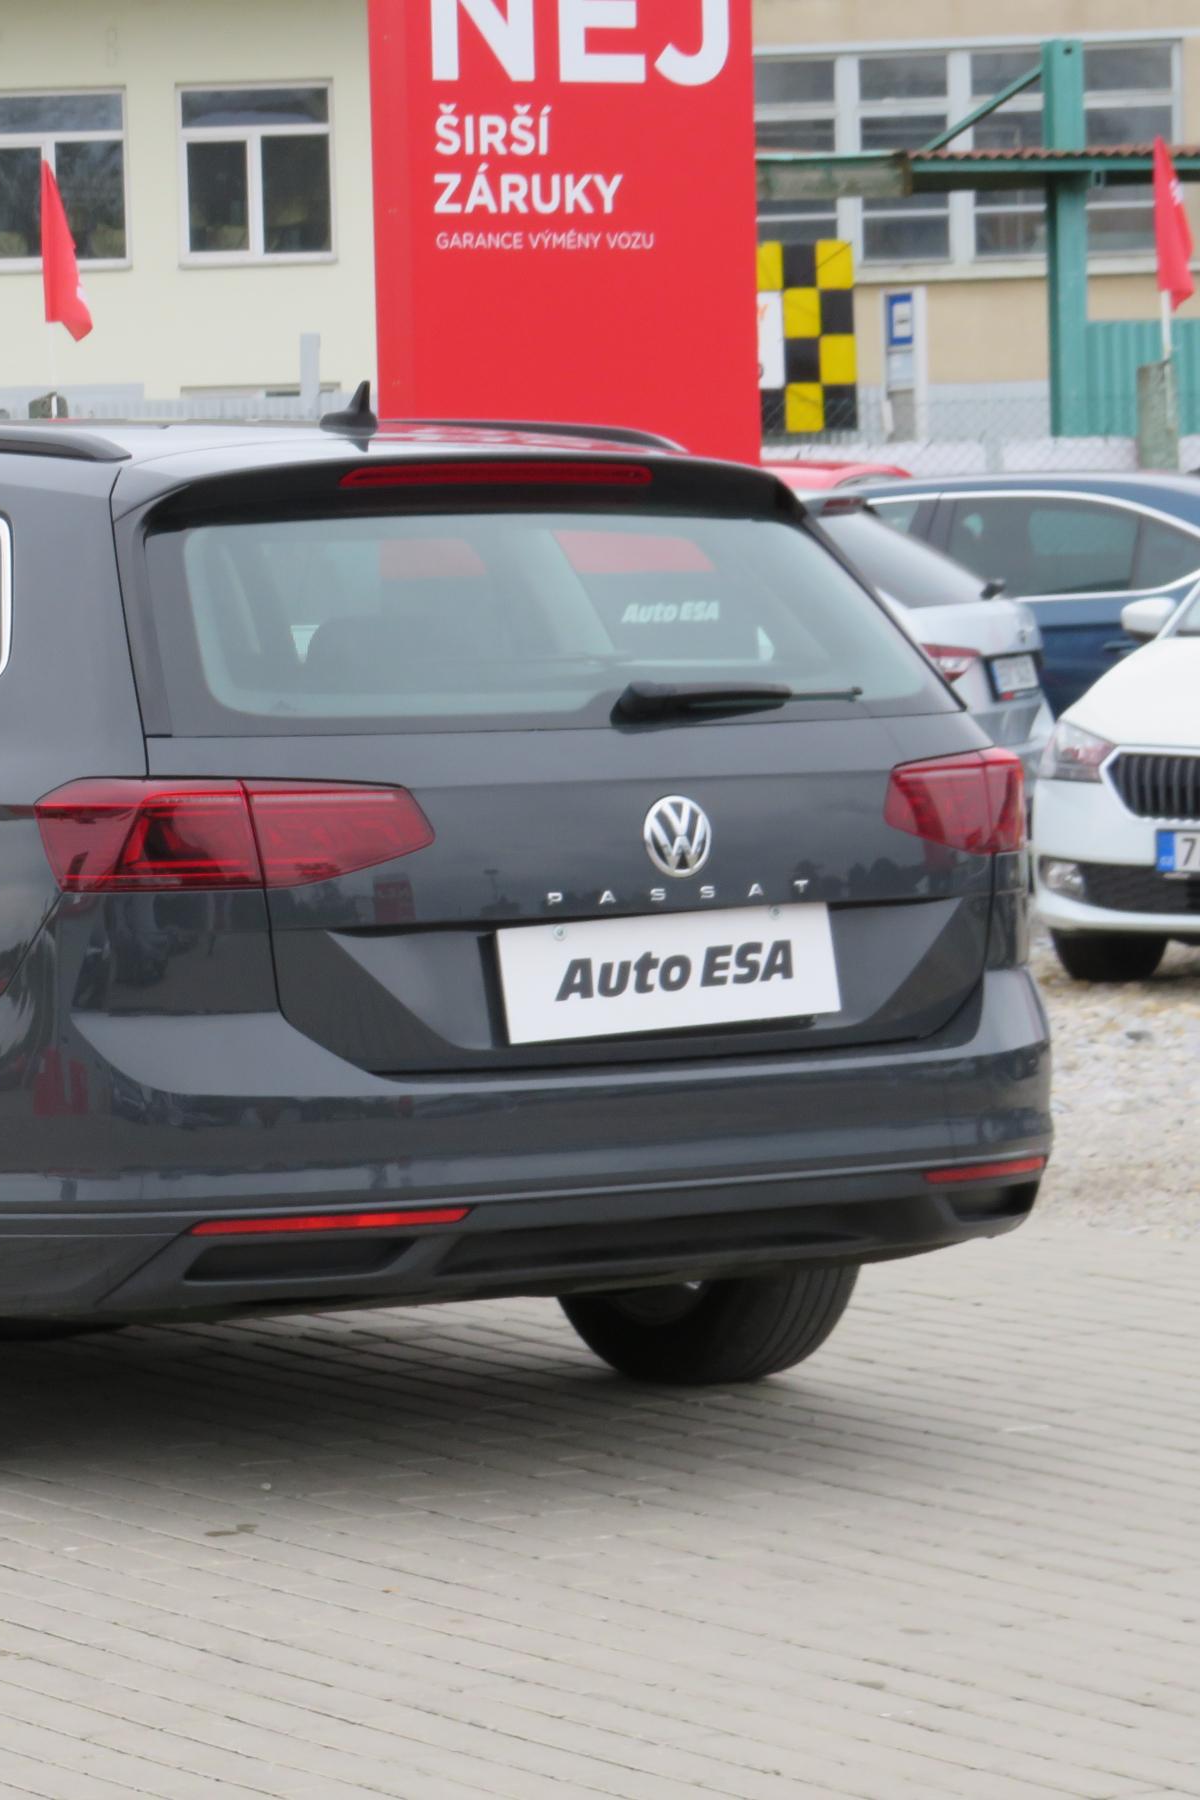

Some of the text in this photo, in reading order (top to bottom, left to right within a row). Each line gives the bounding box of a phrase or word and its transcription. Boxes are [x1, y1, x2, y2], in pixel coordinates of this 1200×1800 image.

[430, 0, 731, 86] NEJ
[434, 103, 553, 156] ŠIRŠÍ
[433, 163, 624, 214] ZÁRUKY
[435, 231, 523, 250] GARANCE
[606, 231, 655, 250] VOZU
[621, 600, 720, 624] Auto ESA
[547, 879, 810, 906] PASSAT
[555, 939, 793, 1002] Auto ESA
